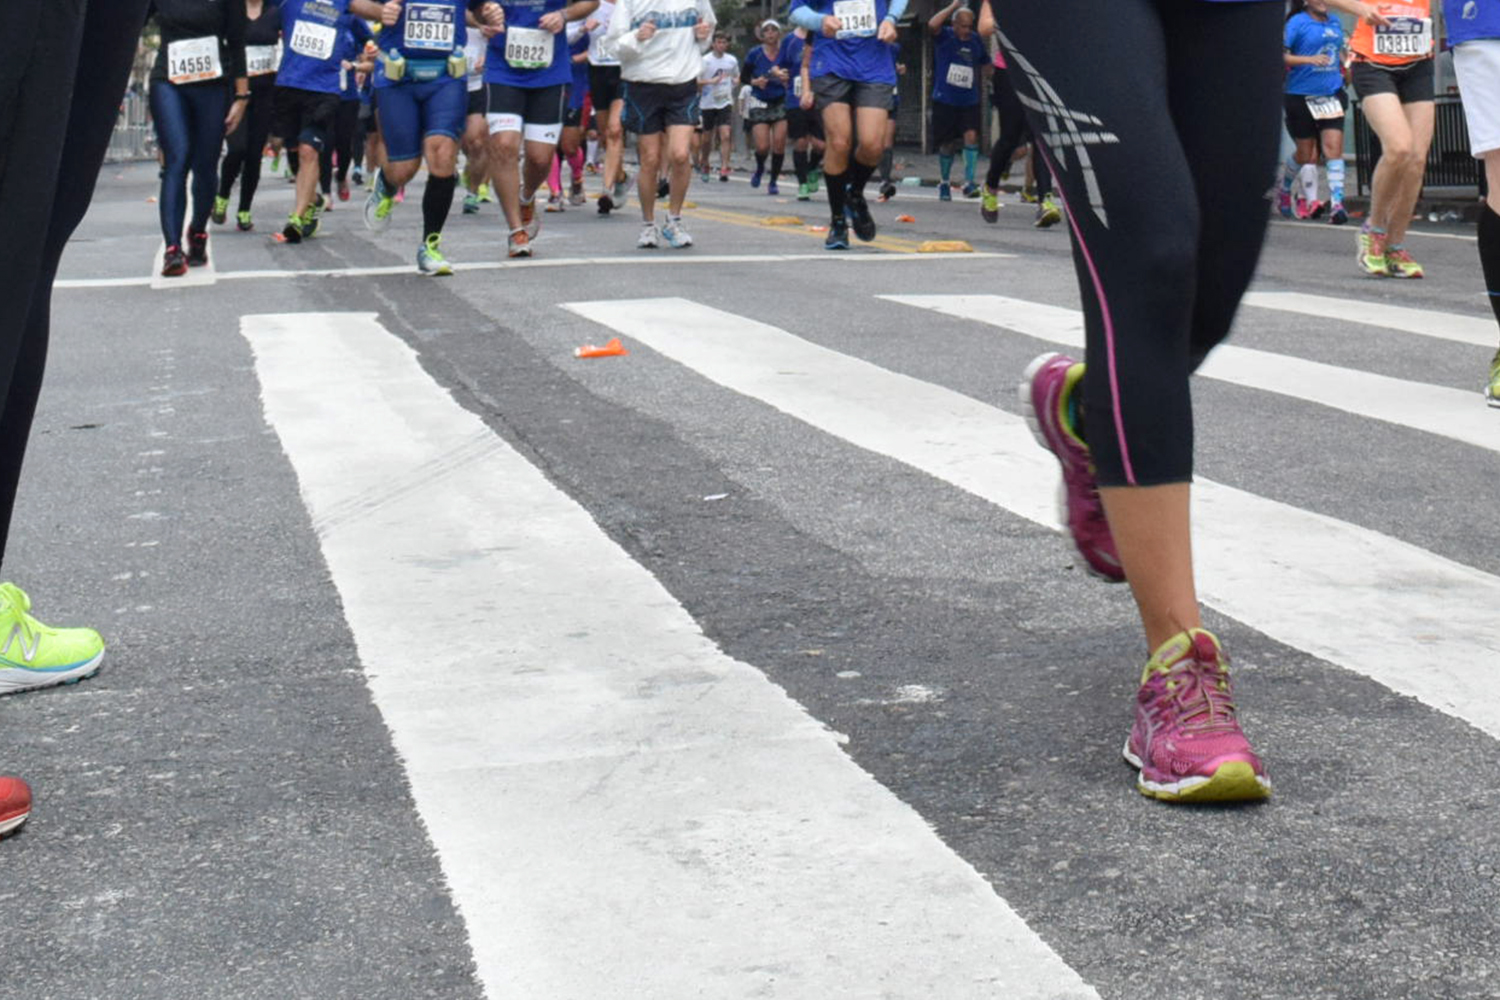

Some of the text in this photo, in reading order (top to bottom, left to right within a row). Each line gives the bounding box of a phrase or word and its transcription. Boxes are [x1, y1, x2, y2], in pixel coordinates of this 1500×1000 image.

[407, 22, 449, 41] 03610
[507, 43, 545, 61] 08822
[1377, 35, 1419, 53] 03810
[170, 54, 212, 76] 14559
